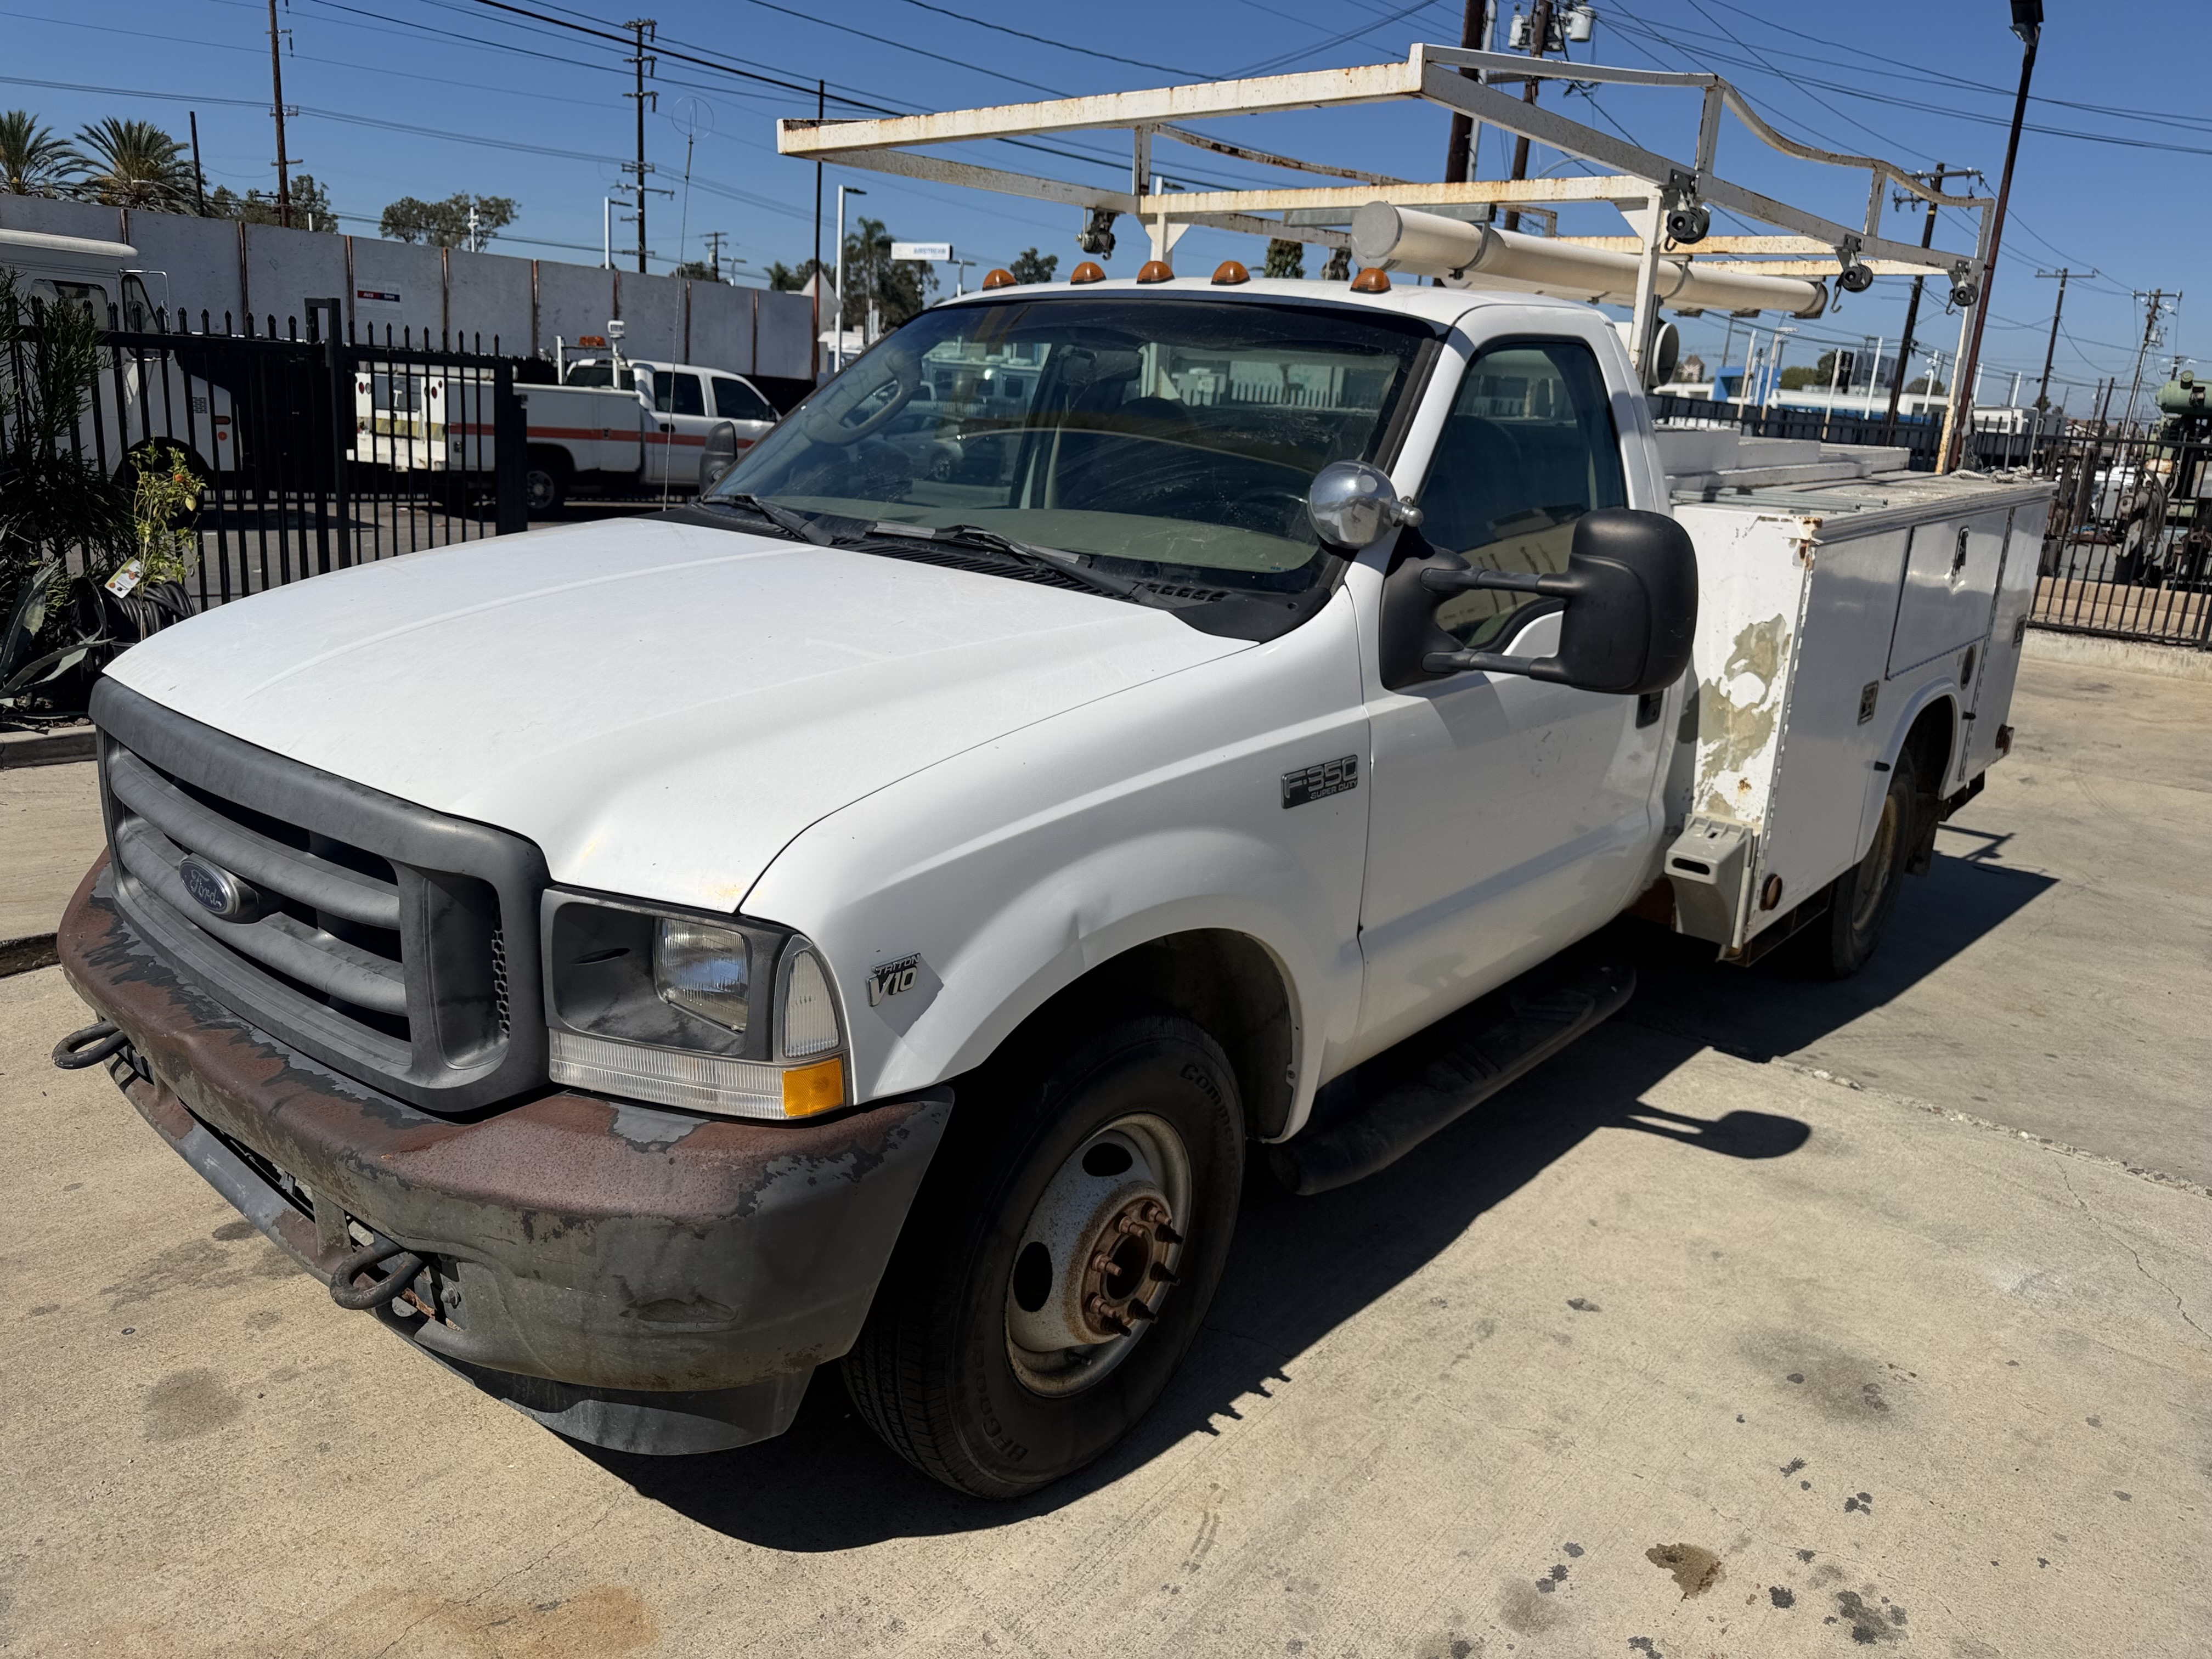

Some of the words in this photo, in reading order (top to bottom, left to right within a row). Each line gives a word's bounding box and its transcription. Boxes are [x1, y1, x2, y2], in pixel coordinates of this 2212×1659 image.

[1310, 786, 1337, 799] SUPER
[1338, 780, 1358, 793] DUTY
[189, 869, 223, 908] Ford
[876, 954, 921, 975] TRITON
[868, 966, 918, 1007] V10
